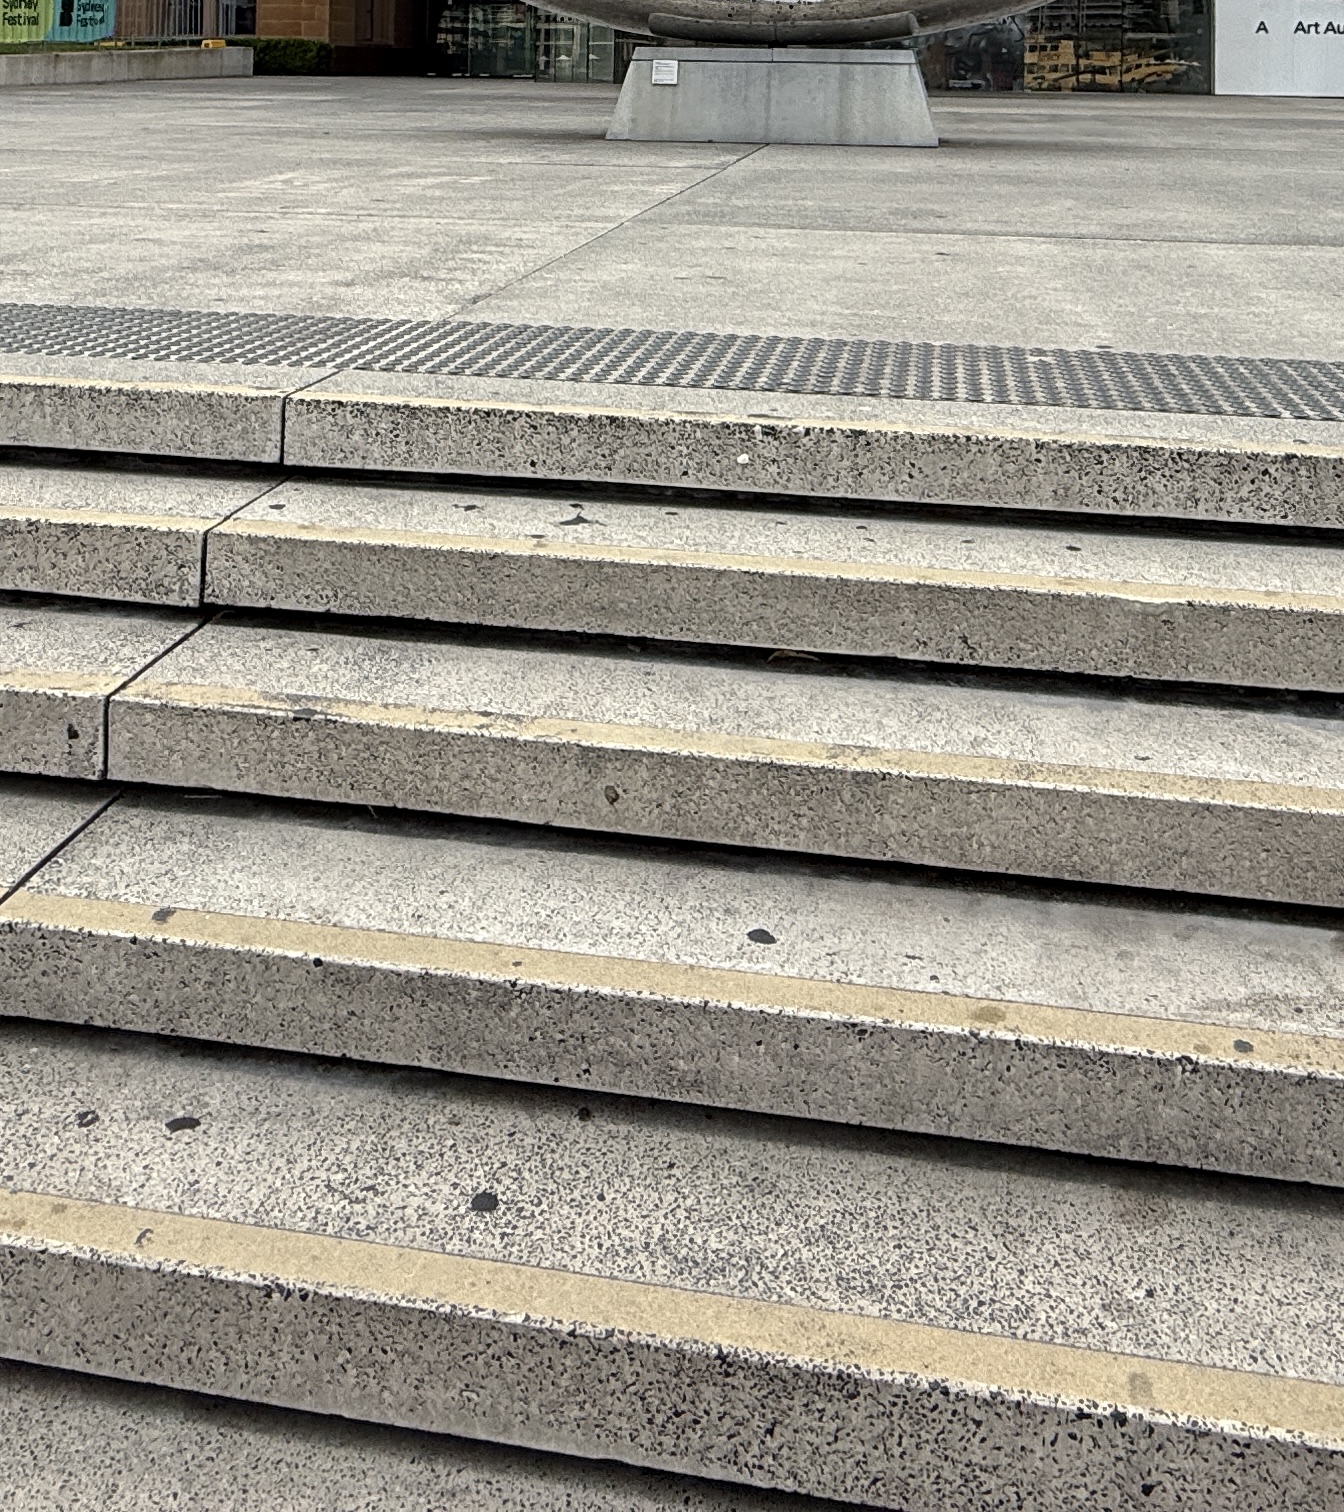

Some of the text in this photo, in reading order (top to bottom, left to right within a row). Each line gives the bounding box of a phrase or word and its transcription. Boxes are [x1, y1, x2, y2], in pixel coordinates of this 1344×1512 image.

[2, 11, 39, 27] Festival
[1255, 20, 1269, 34] A
[1293, 20, 1321, 35] Art
